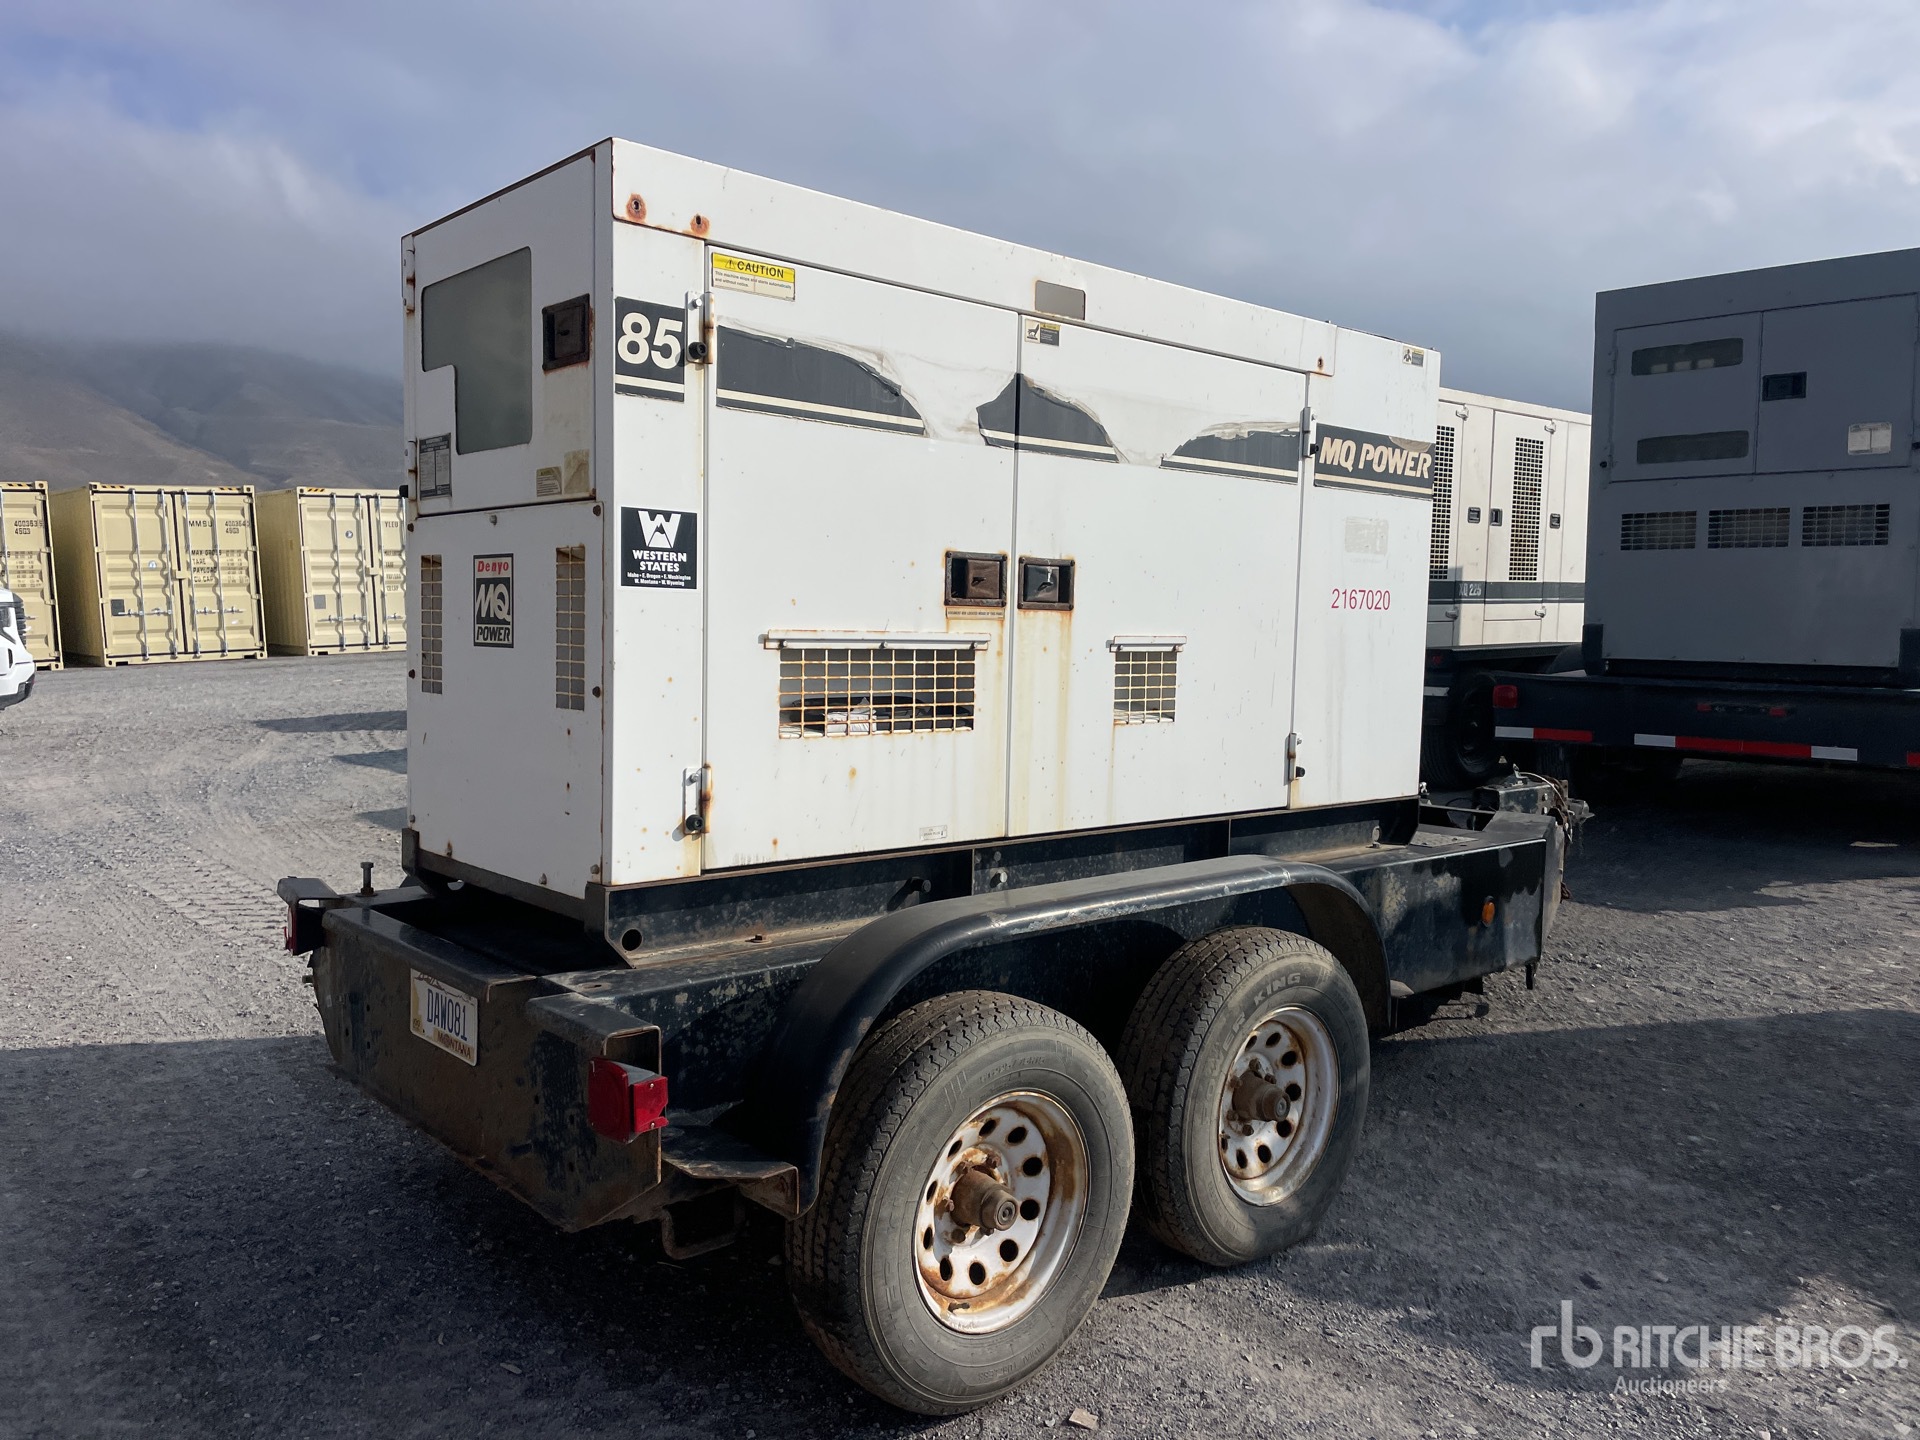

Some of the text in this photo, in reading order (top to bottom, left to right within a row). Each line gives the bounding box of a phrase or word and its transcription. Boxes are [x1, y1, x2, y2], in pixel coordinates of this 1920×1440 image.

[737, 261, 784, 279] CAUTION
[617, 312, 683, 370] 85
[1319, 436, 1432, 480] MQ POWER
[477, 560, 509, 575] Denyo
[632, 549, 687, 563] WESTERN
[640, 561, 680, 572] STATES
[476, 584, 511, 623] MQ
[1331, 588, 1391, 611] 2167020
[476, 626, 511, 642] POWER
[1253, 972, 1301, 1007] KING
[426, 988, 467, 1042] DAW081
[437, 1031, 471, 1059] MONTANA
